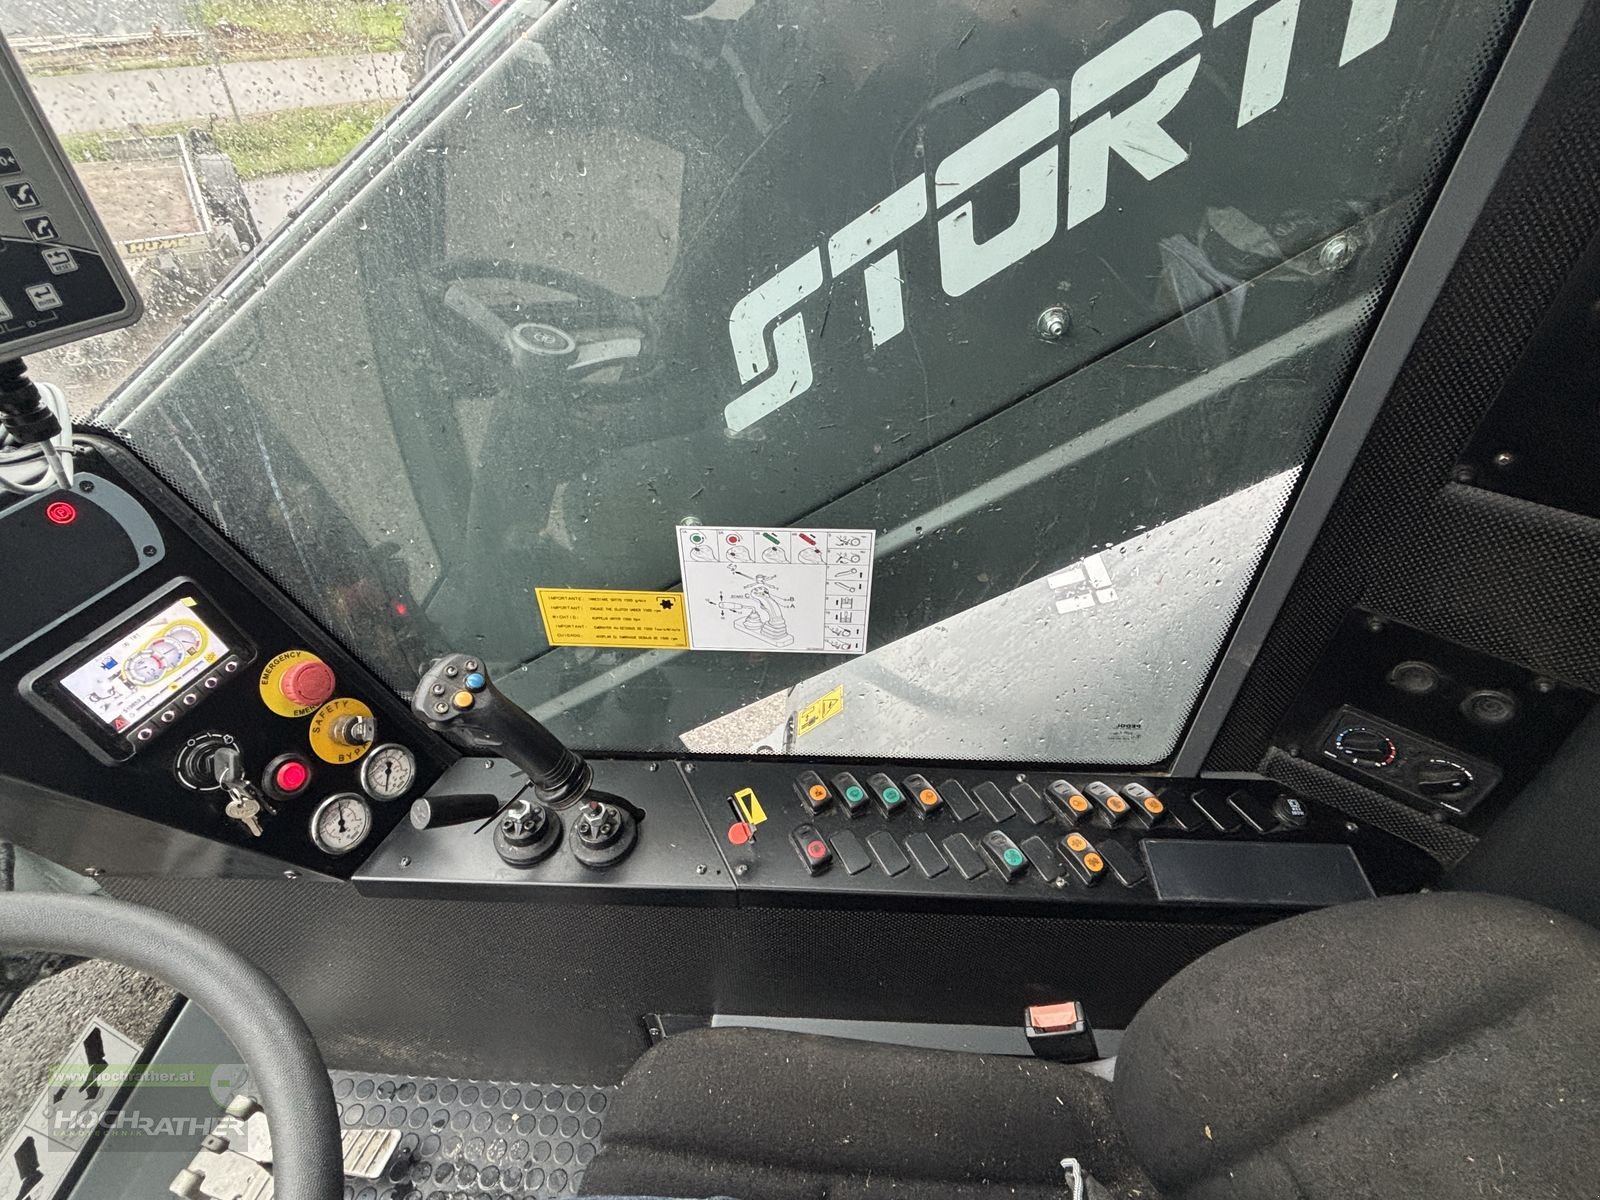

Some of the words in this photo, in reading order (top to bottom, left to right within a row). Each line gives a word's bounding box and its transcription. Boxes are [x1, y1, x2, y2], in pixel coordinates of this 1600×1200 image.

[261, 651, 301, 685] EMERGENCY
[293, 704, 317, 716] EMER
[312, 700, 349, 733] SAFETY
